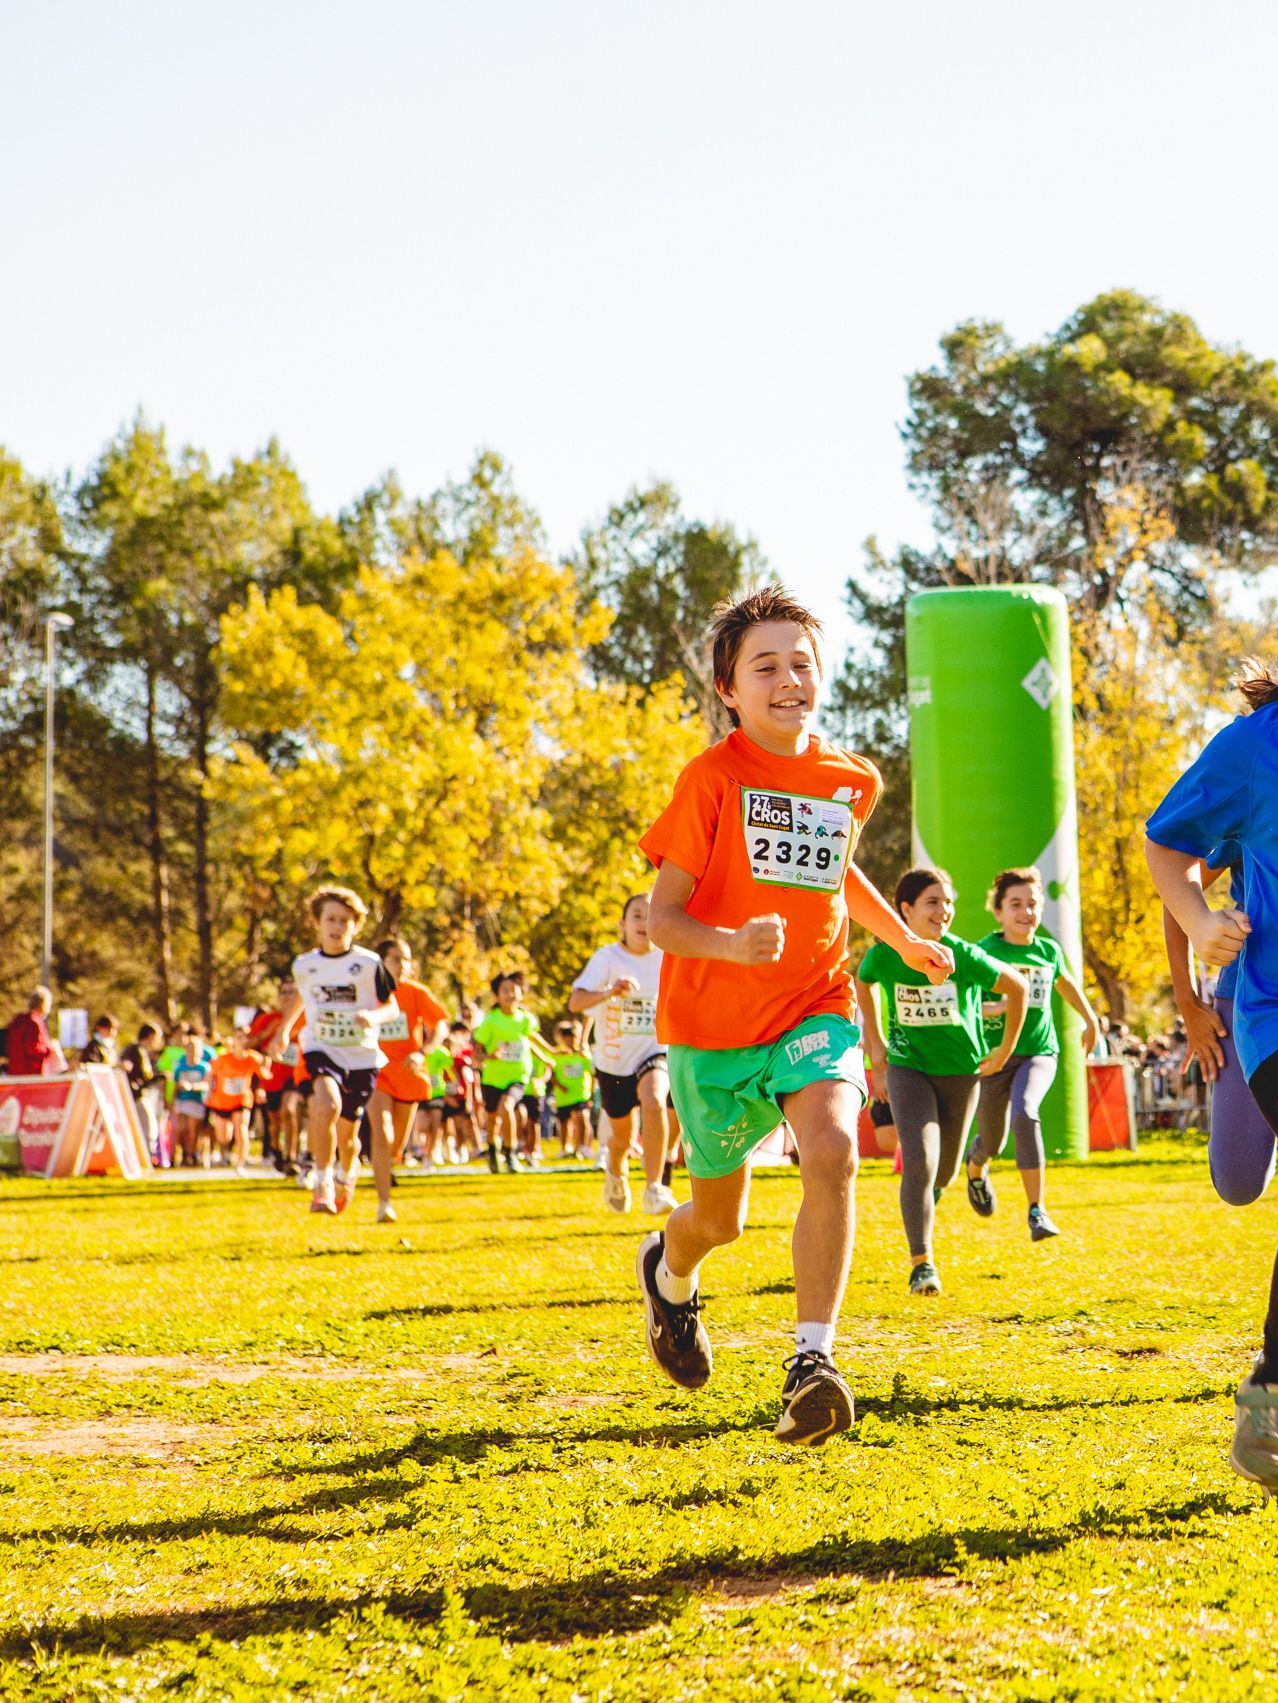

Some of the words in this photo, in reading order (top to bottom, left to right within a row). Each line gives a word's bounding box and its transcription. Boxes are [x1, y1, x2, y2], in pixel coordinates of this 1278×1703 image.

[751, 806, 791, 825] CROS
[753, 838, 831, 870] 2329
[904, 1007, 949, 1018] 2465
[627, 1016, 656, 1026] 277
